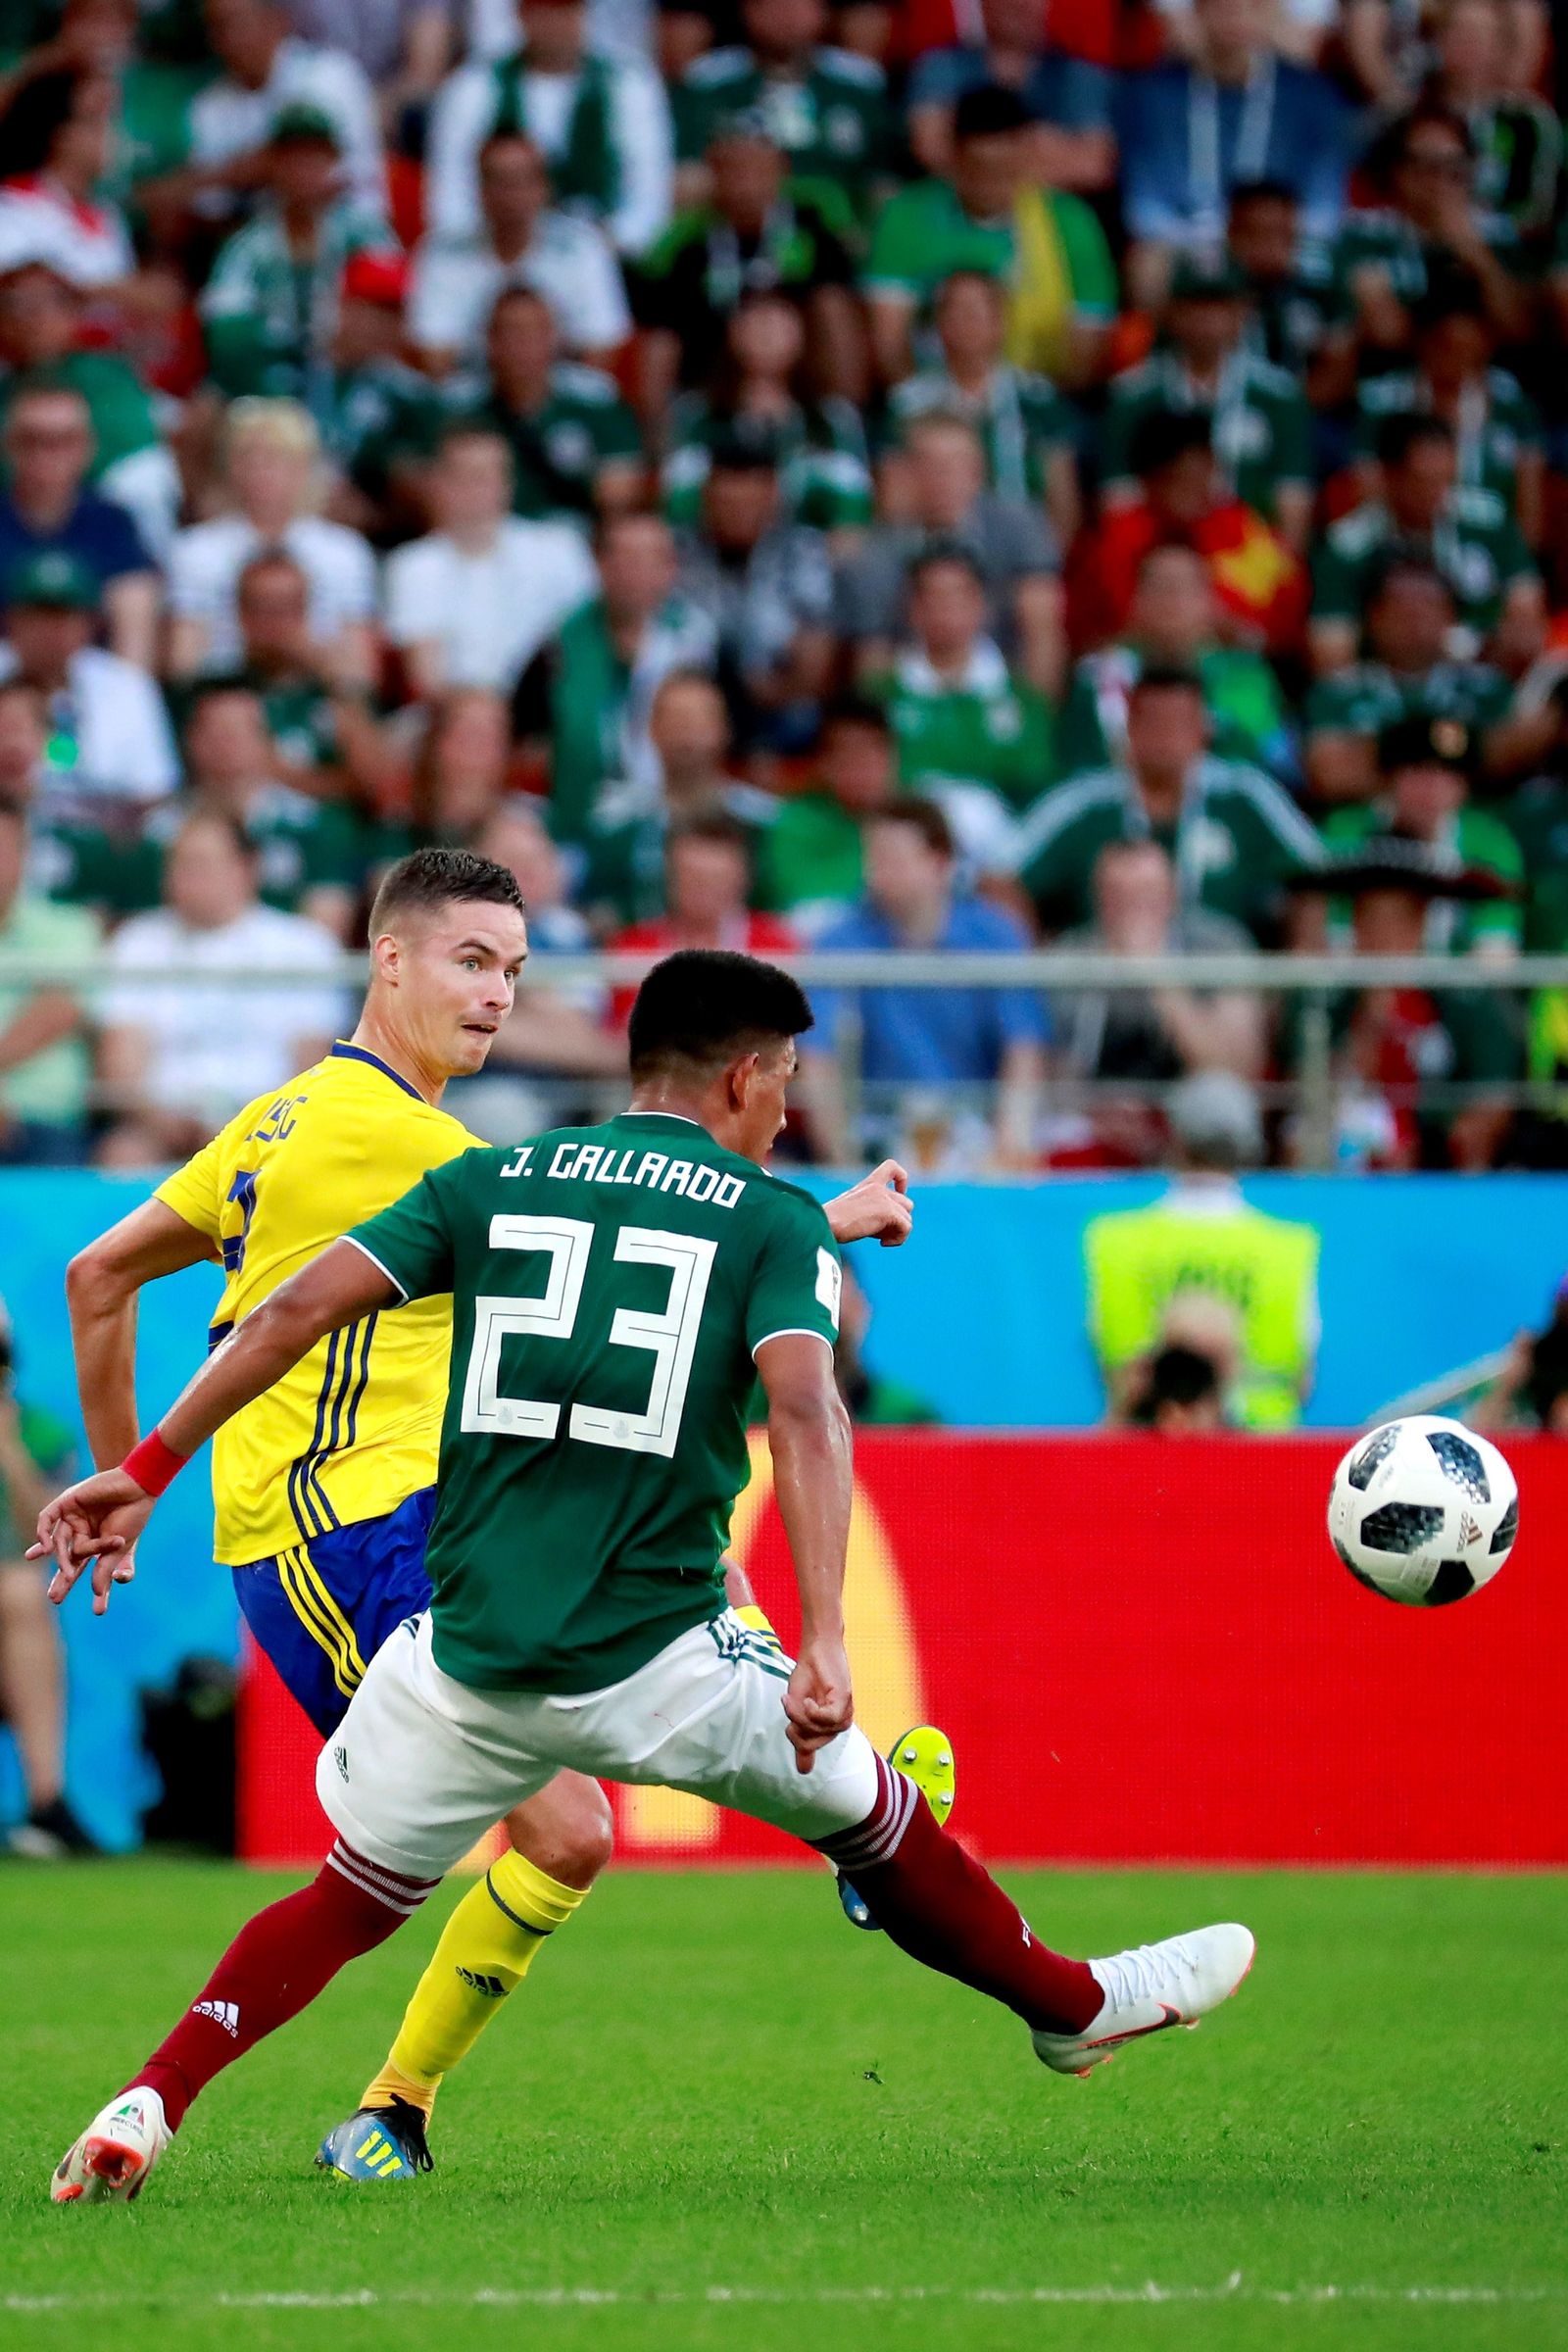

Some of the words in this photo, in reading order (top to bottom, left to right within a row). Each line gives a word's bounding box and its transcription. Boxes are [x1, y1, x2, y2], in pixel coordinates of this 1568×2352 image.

[500, 1147, 534, 1177] J.
[547, 1144, 747, 1208] GALLARDO
[460, 1213, 718, 1459] 23
[192, 2004, 239, 2038] adidas
